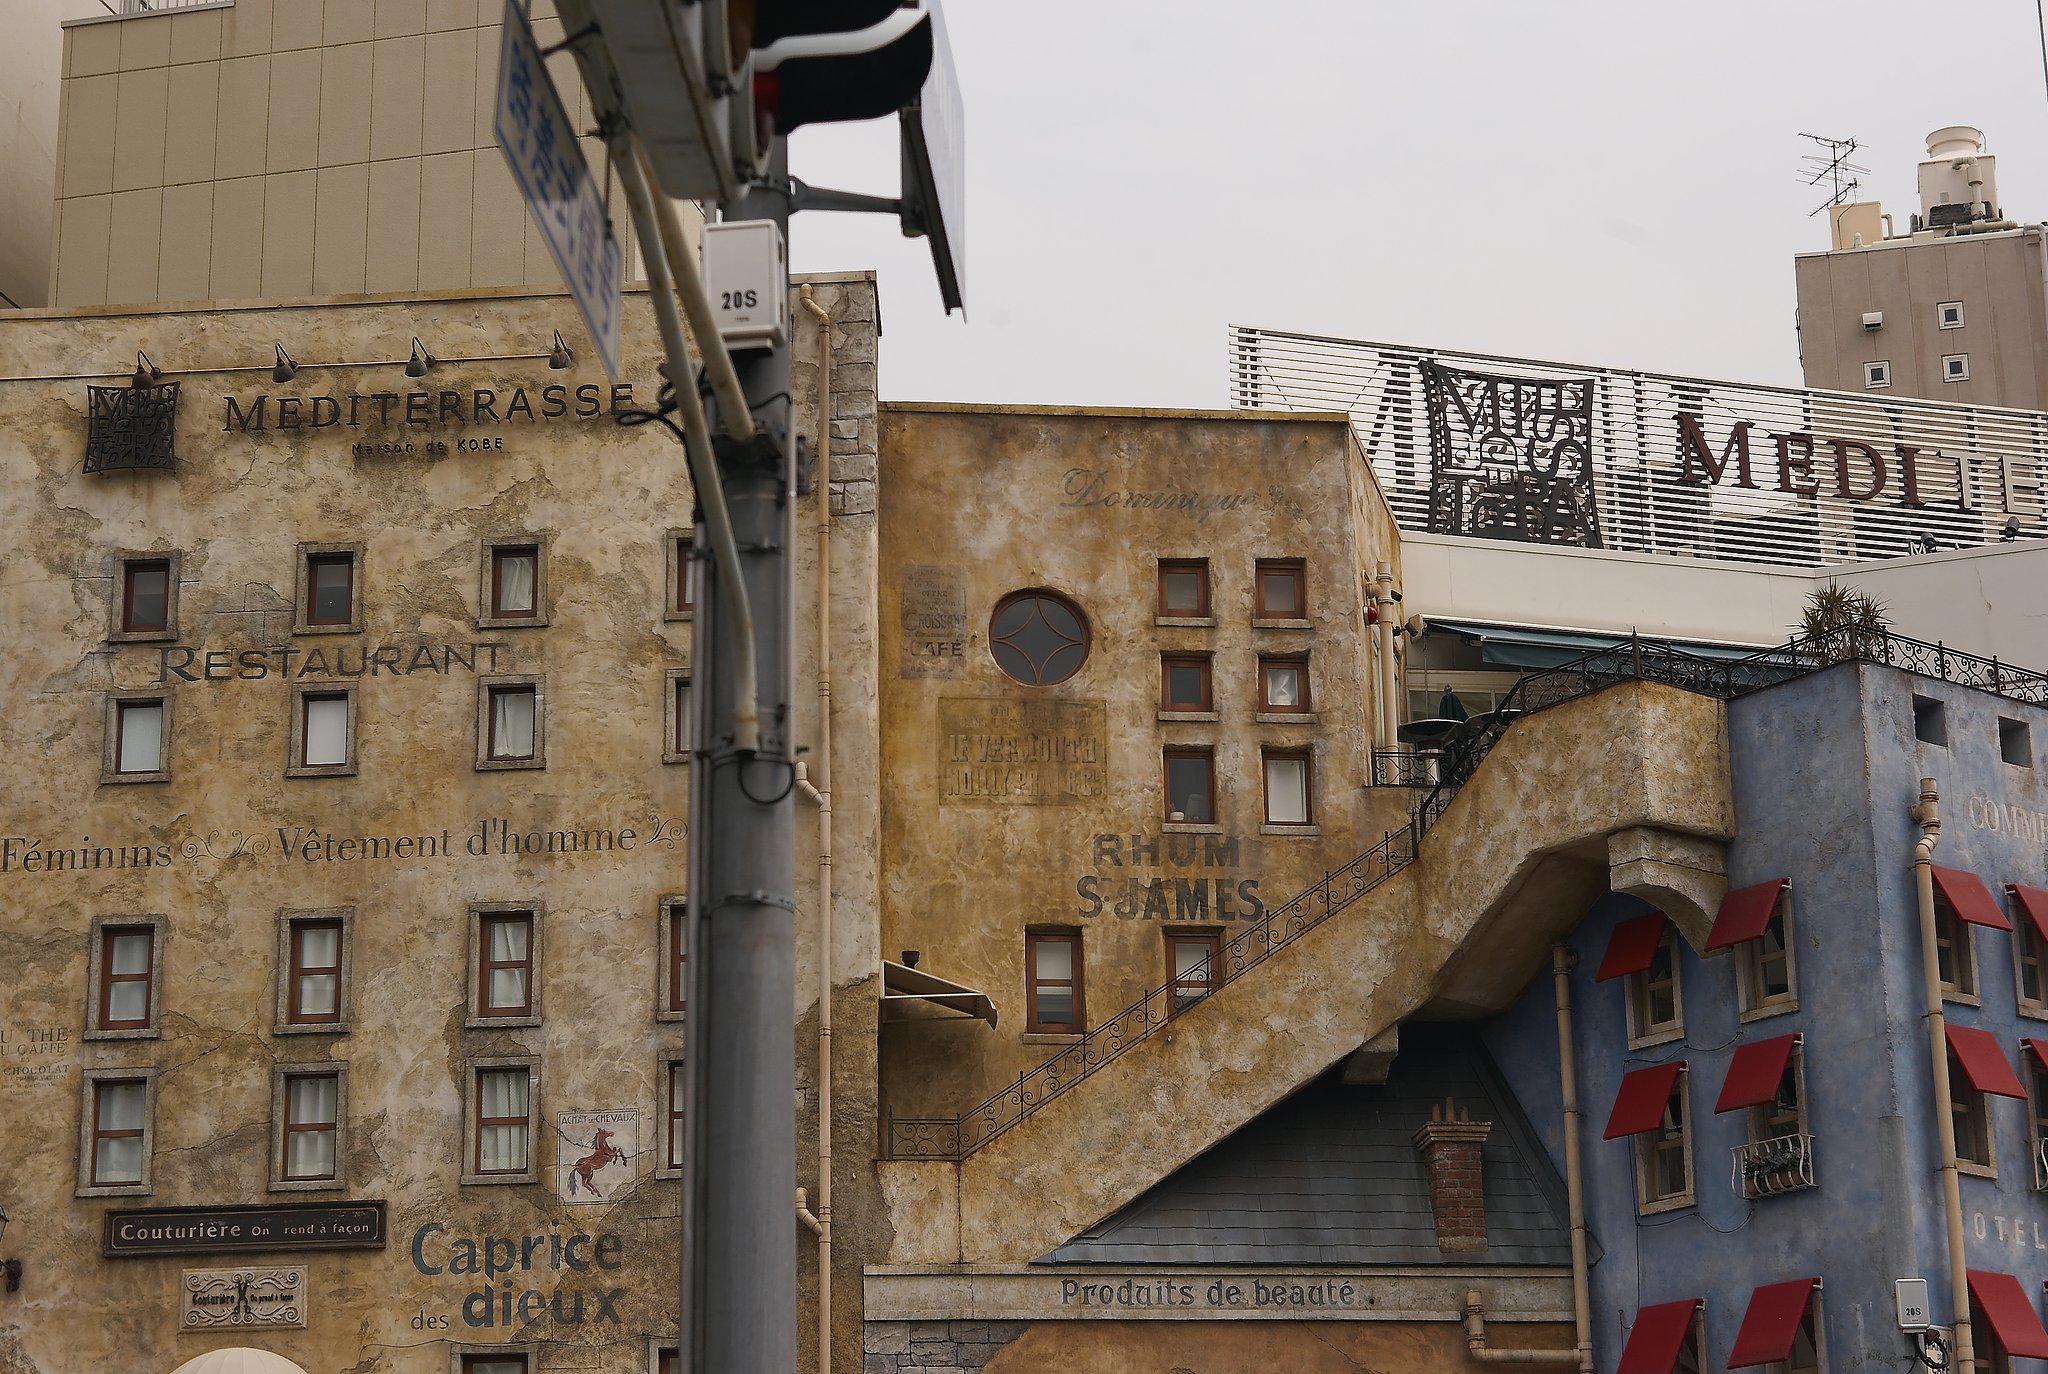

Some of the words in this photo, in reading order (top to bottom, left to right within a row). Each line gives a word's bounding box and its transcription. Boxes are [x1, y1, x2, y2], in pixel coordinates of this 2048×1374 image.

[722, 289, 757, 310] 20S
[222, 383, 634, 433] MEDITERRASSE
[352, 443, 414, 456] Maison
[426, 440, 445, 452] de
[457, 437, 504, 451] KOBE
[155, 641, 507, 683] RESTAURANT
[0, 836, 173, 873] Féminins
[274, 826, 453, 864] Vêtement
[466, 817, 638, 856] d'homme
[1093, 833, 1240, 867] RHUM
[1114, 877, 1265, 922] JAMES
[3, 1064, 70, 1076] CHOCOLAT
[561, 1114, 587, 1125] ACHAT
[595, 1112, 636, 1123] CHEVAUX
[120, 1221, 241, 1241] Couturière
[251, 1226, 270, 1236] On
[284, 1223, 315, 1235] rend
[319, 1223, 327, 1234] à
[332, 1222, 370, 1235] façon
[411, 1218, 623, 1282] Caprice
[192, 1293, 235, 1306] Couturière
[411, 1309, 449, 1330] des
[462, 1279, 628, 1328] dieux
[1061, 1278, 1195, 1306] Produits
[1206, 1278, 1242, 1306] de
[1253, 1278, 1355, 1306] beauté
[1905, 1307, 1922, 1316] 20S
